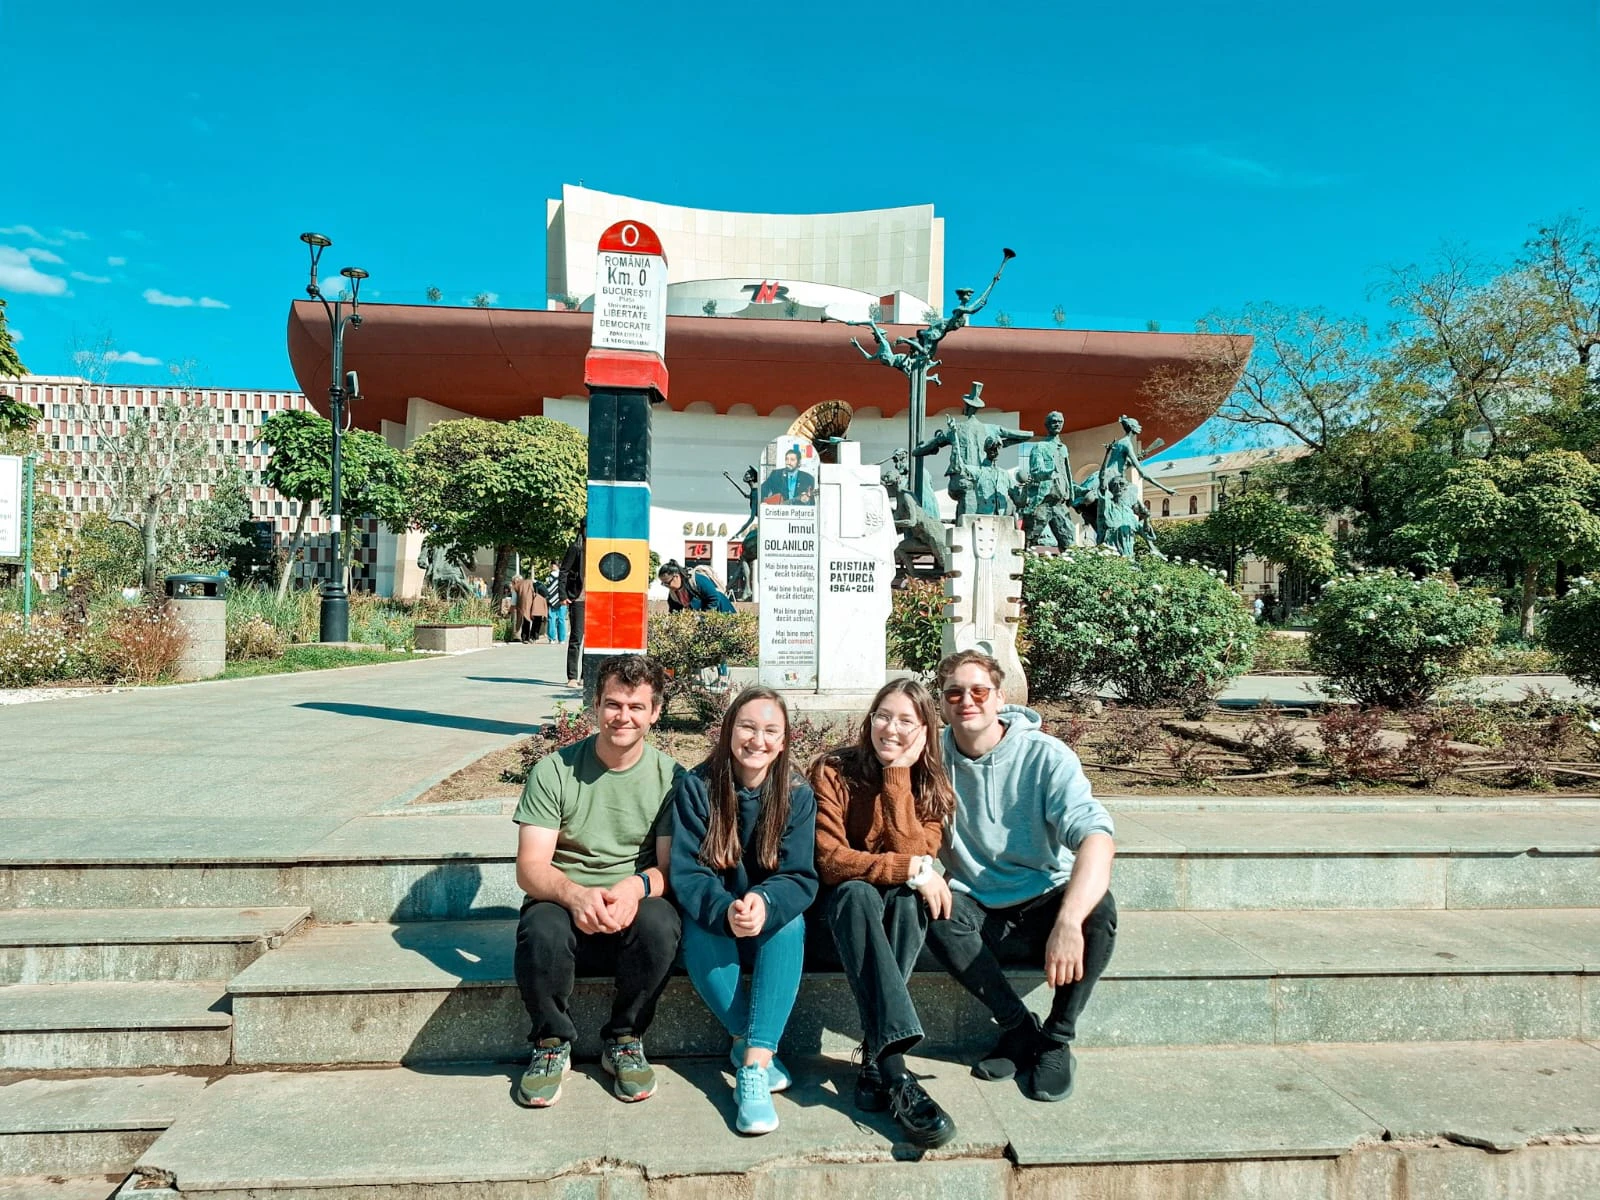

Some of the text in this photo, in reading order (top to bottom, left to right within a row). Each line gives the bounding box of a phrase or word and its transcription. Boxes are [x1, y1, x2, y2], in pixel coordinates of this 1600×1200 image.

[604, 255, 651, 268] ROMÂNIA
[607, 266, 647, 286] Km. 0
[603, 308, 648, 320] LIBERTATE
[764, 508, 789, 517] Cristian
[682, 521, 728, 537] SALA
[788, 522, 815, 535] Imnul
[764, 539, 815, 552] GOLANILOR
[776, 562, 789, 570] bine
[830, 561, 876, 571] CRISTIAN
[773, 607, 784, 615] Mai
